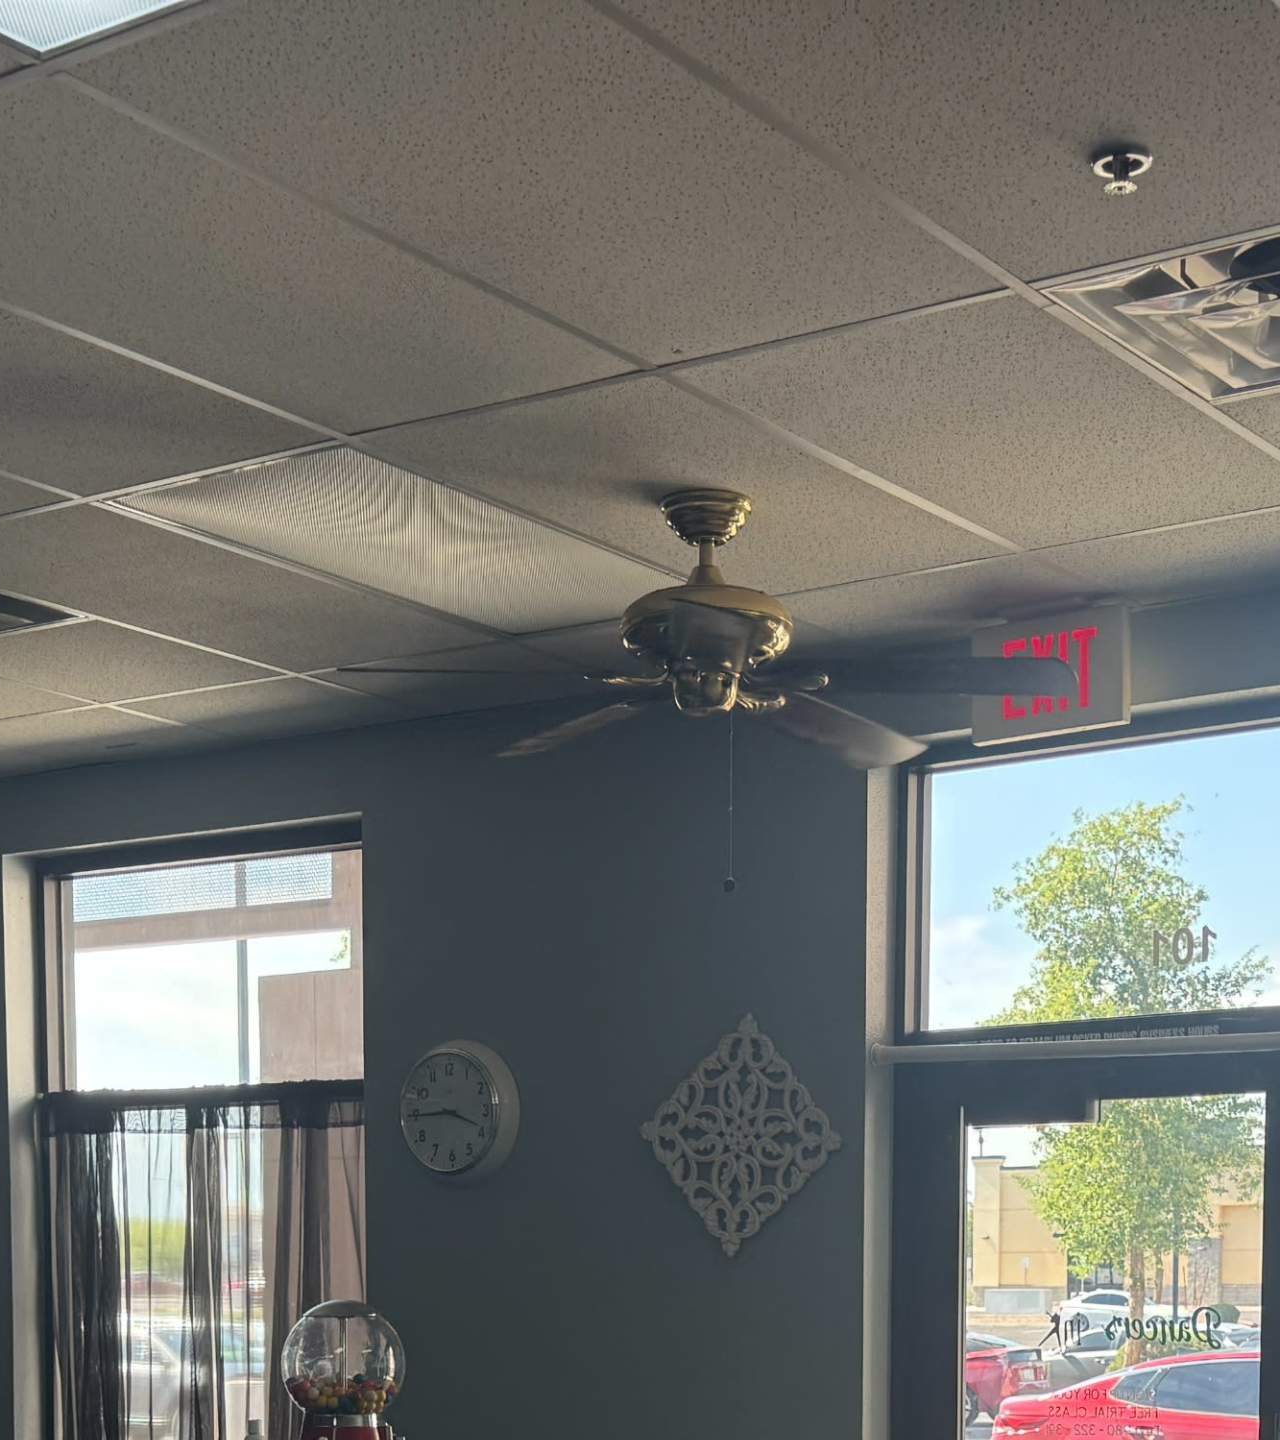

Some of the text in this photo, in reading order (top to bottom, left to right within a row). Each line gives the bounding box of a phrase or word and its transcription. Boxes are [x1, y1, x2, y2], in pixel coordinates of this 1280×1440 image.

[429, 1069, 436, 1083] 11
[444, 1063, 455, 1077] 12
[416, 1087, 429, 1101] 10
[477, 1081, 485, 1095] 2
[482, 1104, 490, 1118] 3
[417, 1129, 426, 1142] 8
[478, 1125, 485, 1139] 4
[432, 1143, 439, 1157] 7
[448, 1148, 456, 1162] 6
[465, 1142, 473, 1156] 5
